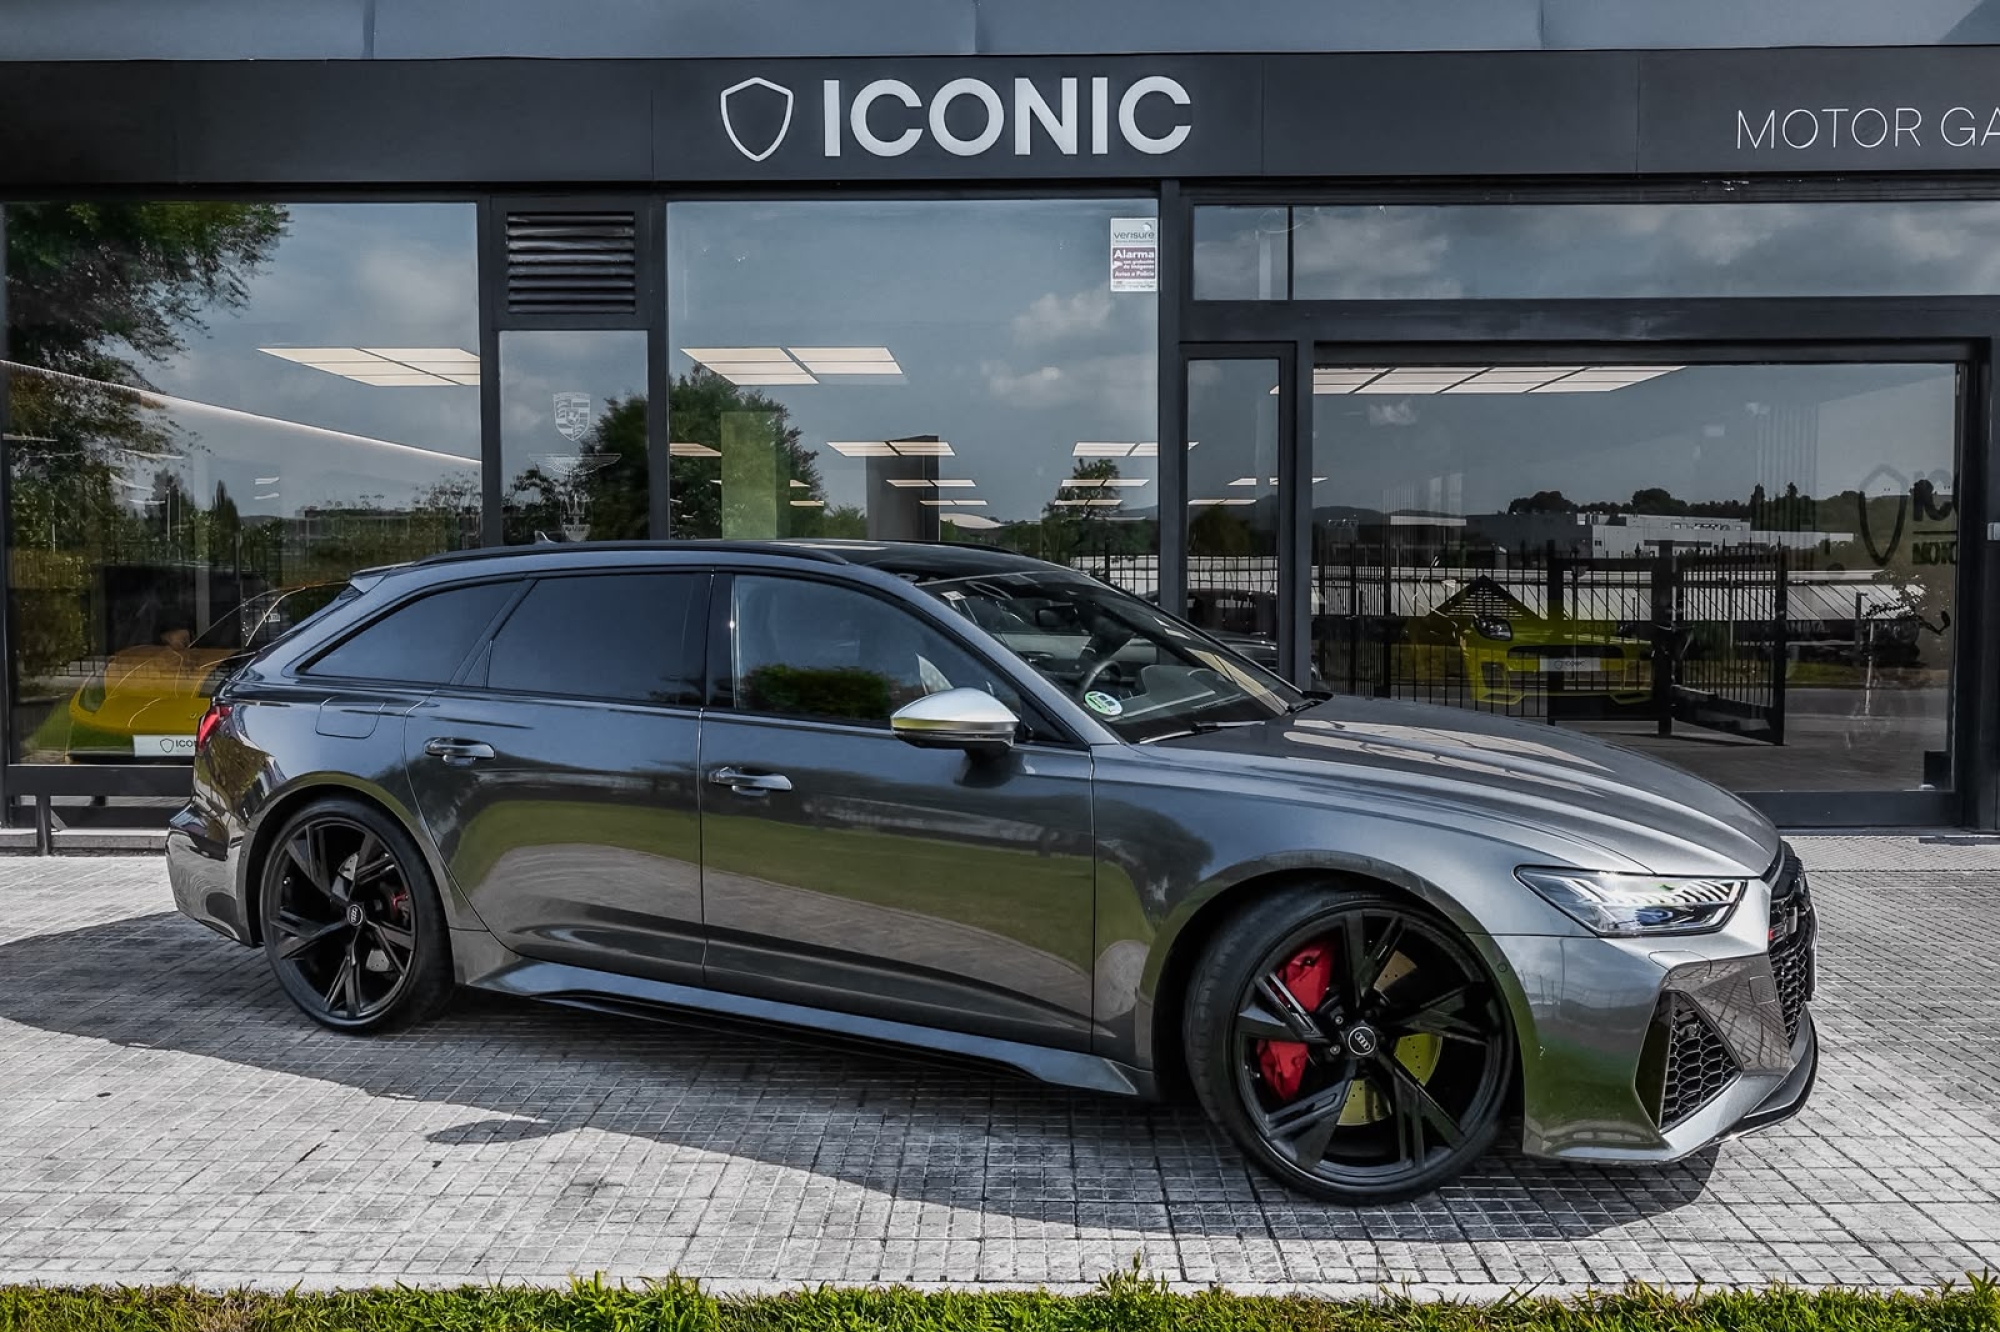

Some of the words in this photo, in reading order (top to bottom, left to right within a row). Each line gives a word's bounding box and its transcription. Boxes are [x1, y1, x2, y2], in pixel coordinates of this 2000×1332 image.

[824, 76, 1192, 157] ICONIC
[1737, 107, 1923, 149] MOTOR
[1114, 249, 1155, 259] Alarma
[1913, 470, 1958, 521] IC
[175, 740, 197, 748] ICO
